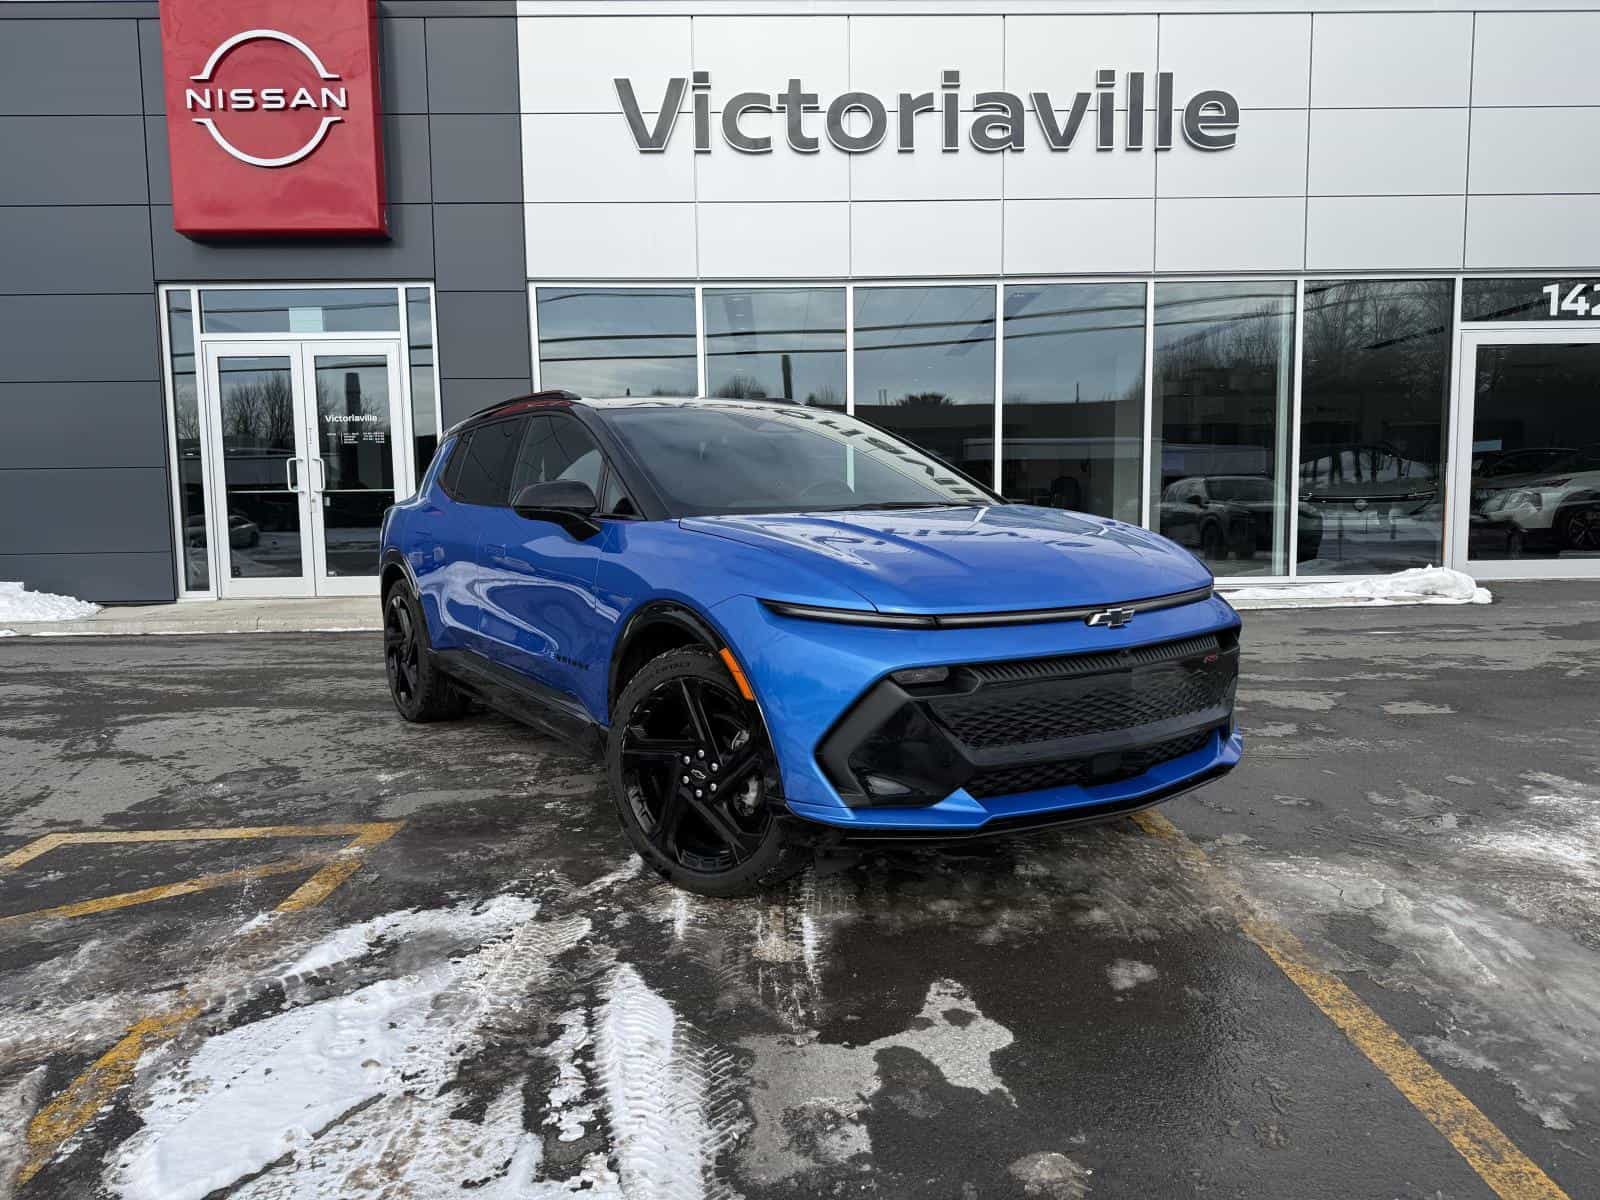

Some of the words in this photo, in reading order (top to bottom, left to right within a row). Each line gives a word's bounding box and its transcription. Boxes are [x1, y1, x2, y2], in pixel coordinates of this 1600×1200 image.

[185, 87, 348, 110] NISSAN
[613, 69, 1241, 154] Victoriaville
[325, 414, 378, 422] Victoriaville
